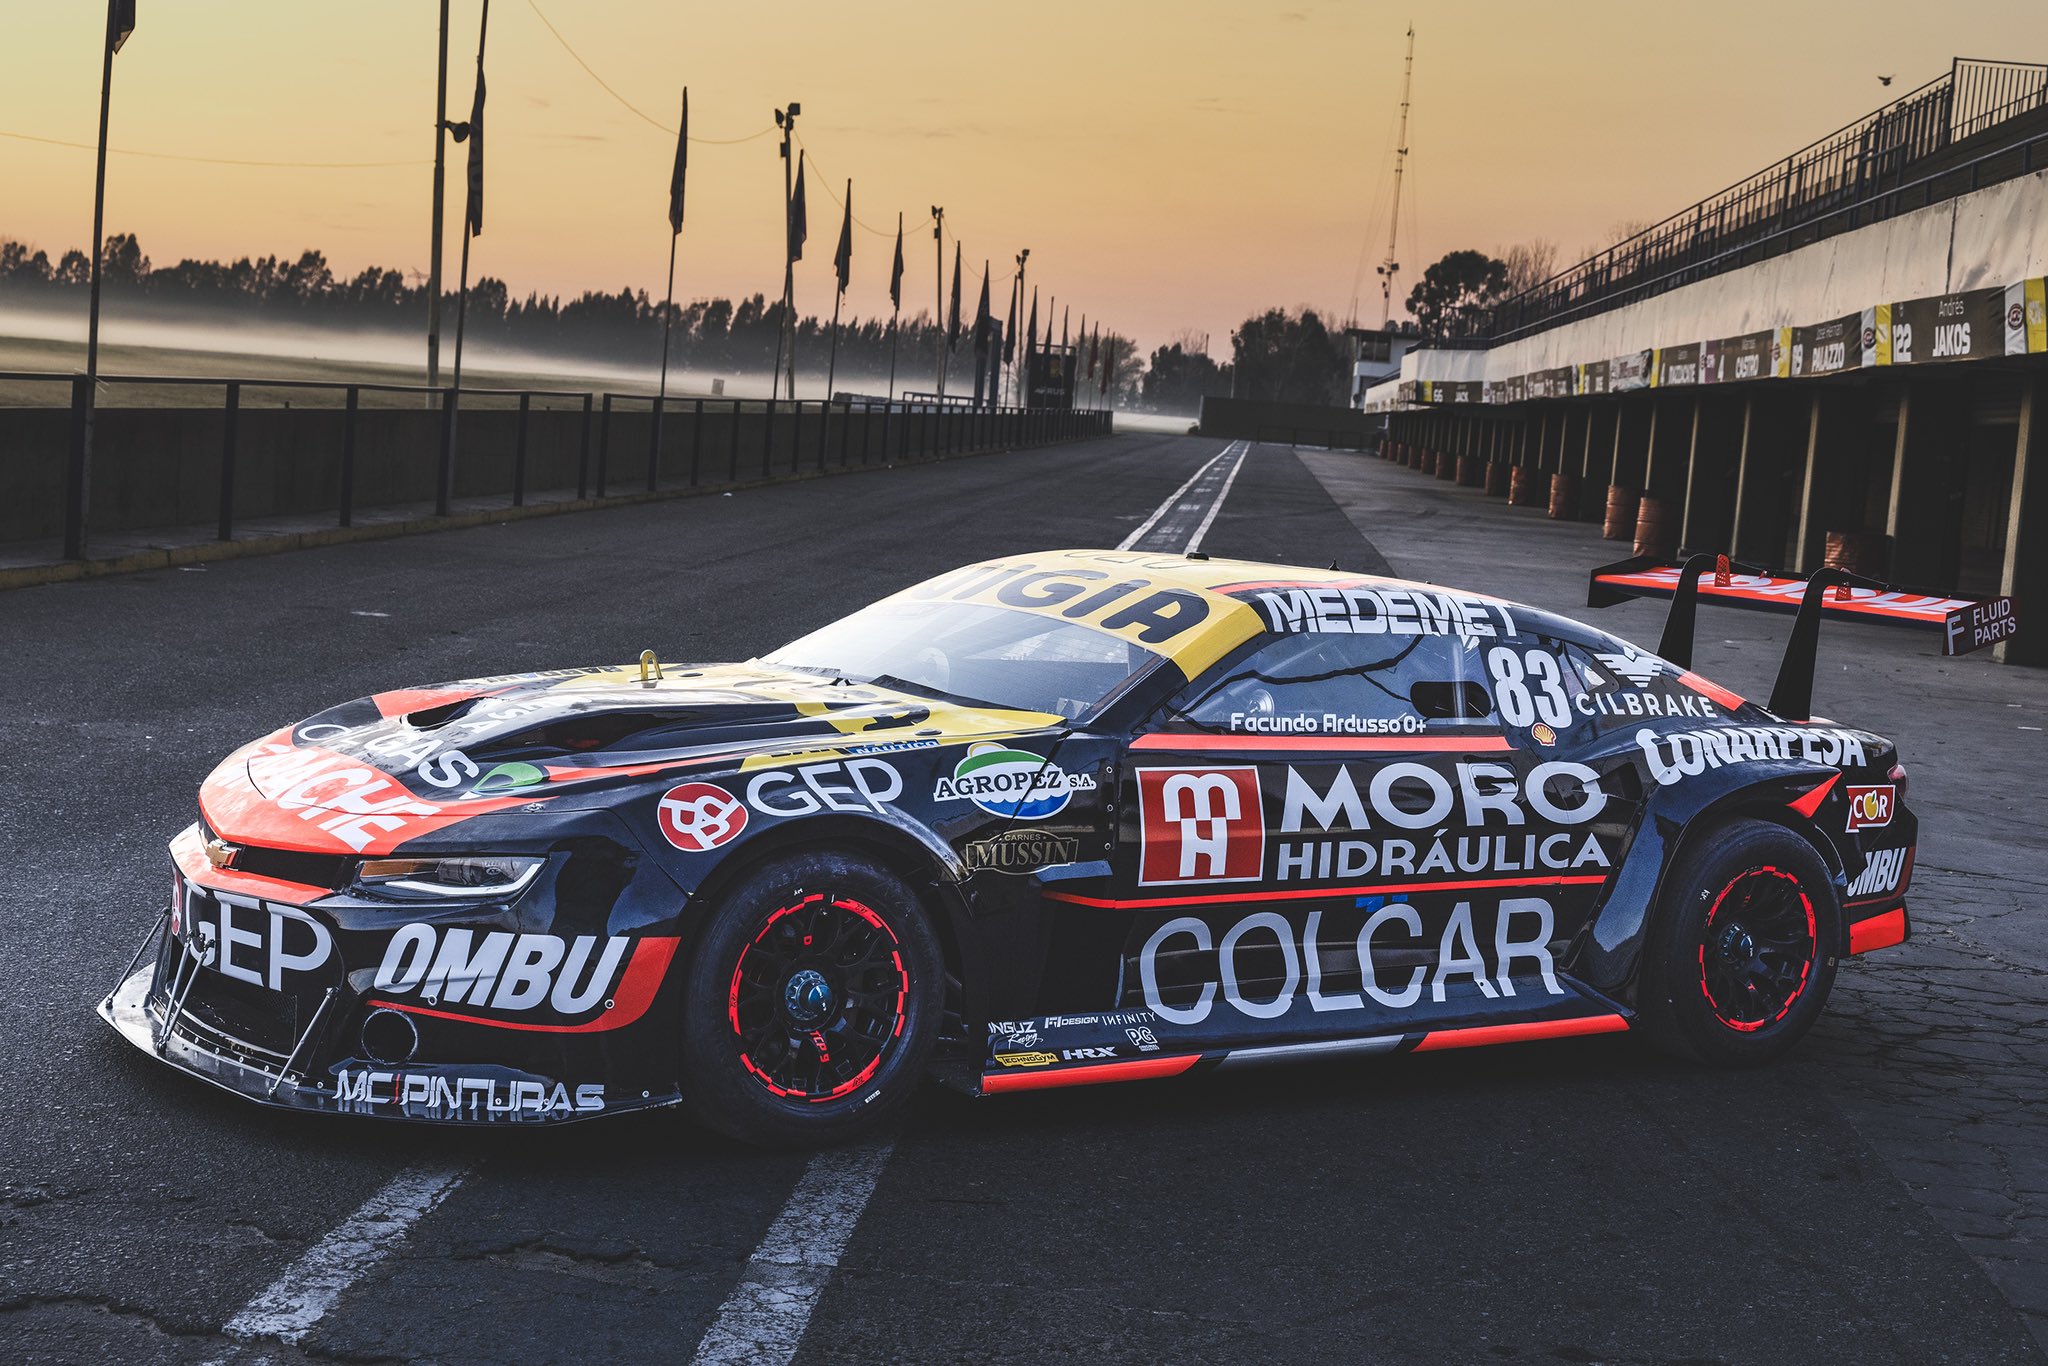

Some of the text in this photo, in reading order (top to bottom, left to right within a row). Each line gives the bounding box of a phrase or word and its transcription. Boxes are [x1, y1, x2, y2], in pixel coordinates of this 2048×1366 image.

[1932, 322, 1971, 357] JAKOS
[1811, 342, 1845, 373] PALAZZO
[1256, 589, 1517, 637] MEDEMET
[1973, 599, 2011, 626] FLUID
[1974, 617, 2016, 646] PARTS
[1487, 646, 1573, 729] 83
[1575, 692, 1718, 719] CILBRAKE
[1230, 712, 1318, 733] Facundo
[1323, 713, 1401, 734] Ardusso
[1635, 727, 1868, 786] CONARPESA
[745, 758, 904, 817] GEP
[937, 770, 1095, 798] AGROPEZ S.A.
[1280, 761, 1608, 833] MORO
[1004, 833, 1041, 842] CARNES
[976, 841, 1070, 868] MUSSIN
[1276, 828, 1612, 881] HIDRÁULICA
[183, 878, 333, 992] GEP
[373, 922, 631, 1014] OMBU
[1139, 897, 1566, 1024] COLCAR
[988, 1021, 1037, 1034] INGUZ
[1101, 1011, 1156, 1026] INFINITY
[1006, 1032, 1044, 1050] Racing
[1125, 1026, 1158, 1046] PG
[1062, 1046, 1118, 1060] HRX
[399, 1073, 605, 1112] PINTURAS
